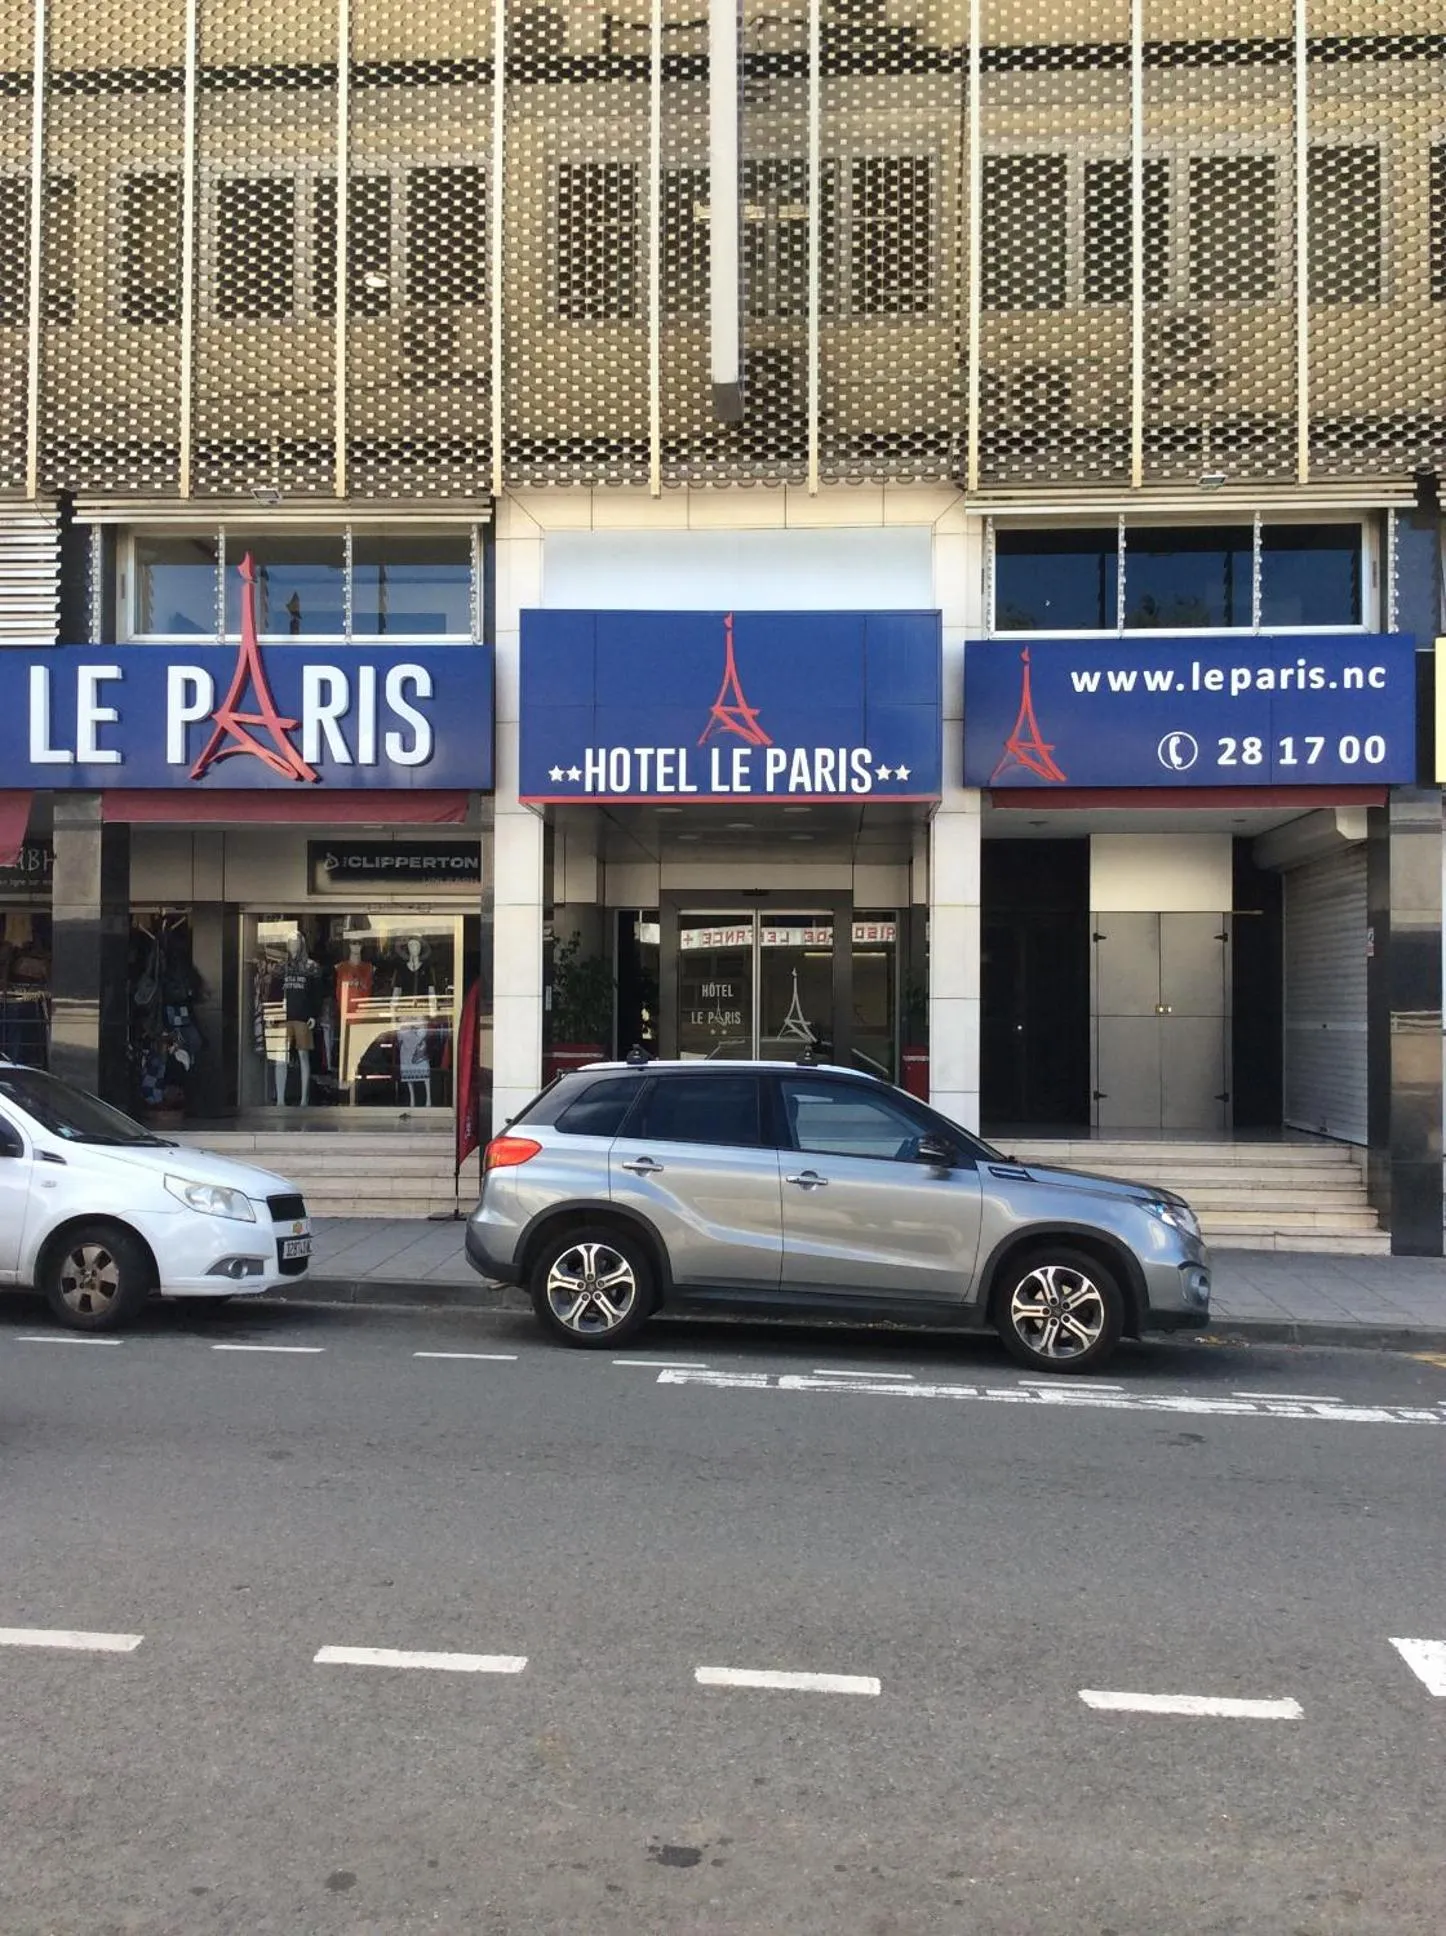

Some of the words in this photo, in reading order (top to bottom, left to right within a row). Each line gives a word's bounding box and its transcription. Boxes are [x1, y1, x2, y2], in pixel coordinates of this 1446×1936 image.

[1070, 658, 1387, 696] www.leparis.nc
[29, 665, 123, 764] LE
[1216, 737, 1263, 766] 28
[1278, 736, 1325, 765] 17
[1338, 735, 1387, 764] 00
[584, 747, 698, 793] HOTEL
[711, 747, 752, 793] LE
[766, 746, 873, 794] PARIS
[348, 856, 479, 869] CLIPPERTON
[691, 1011, 704, 1025] LE
